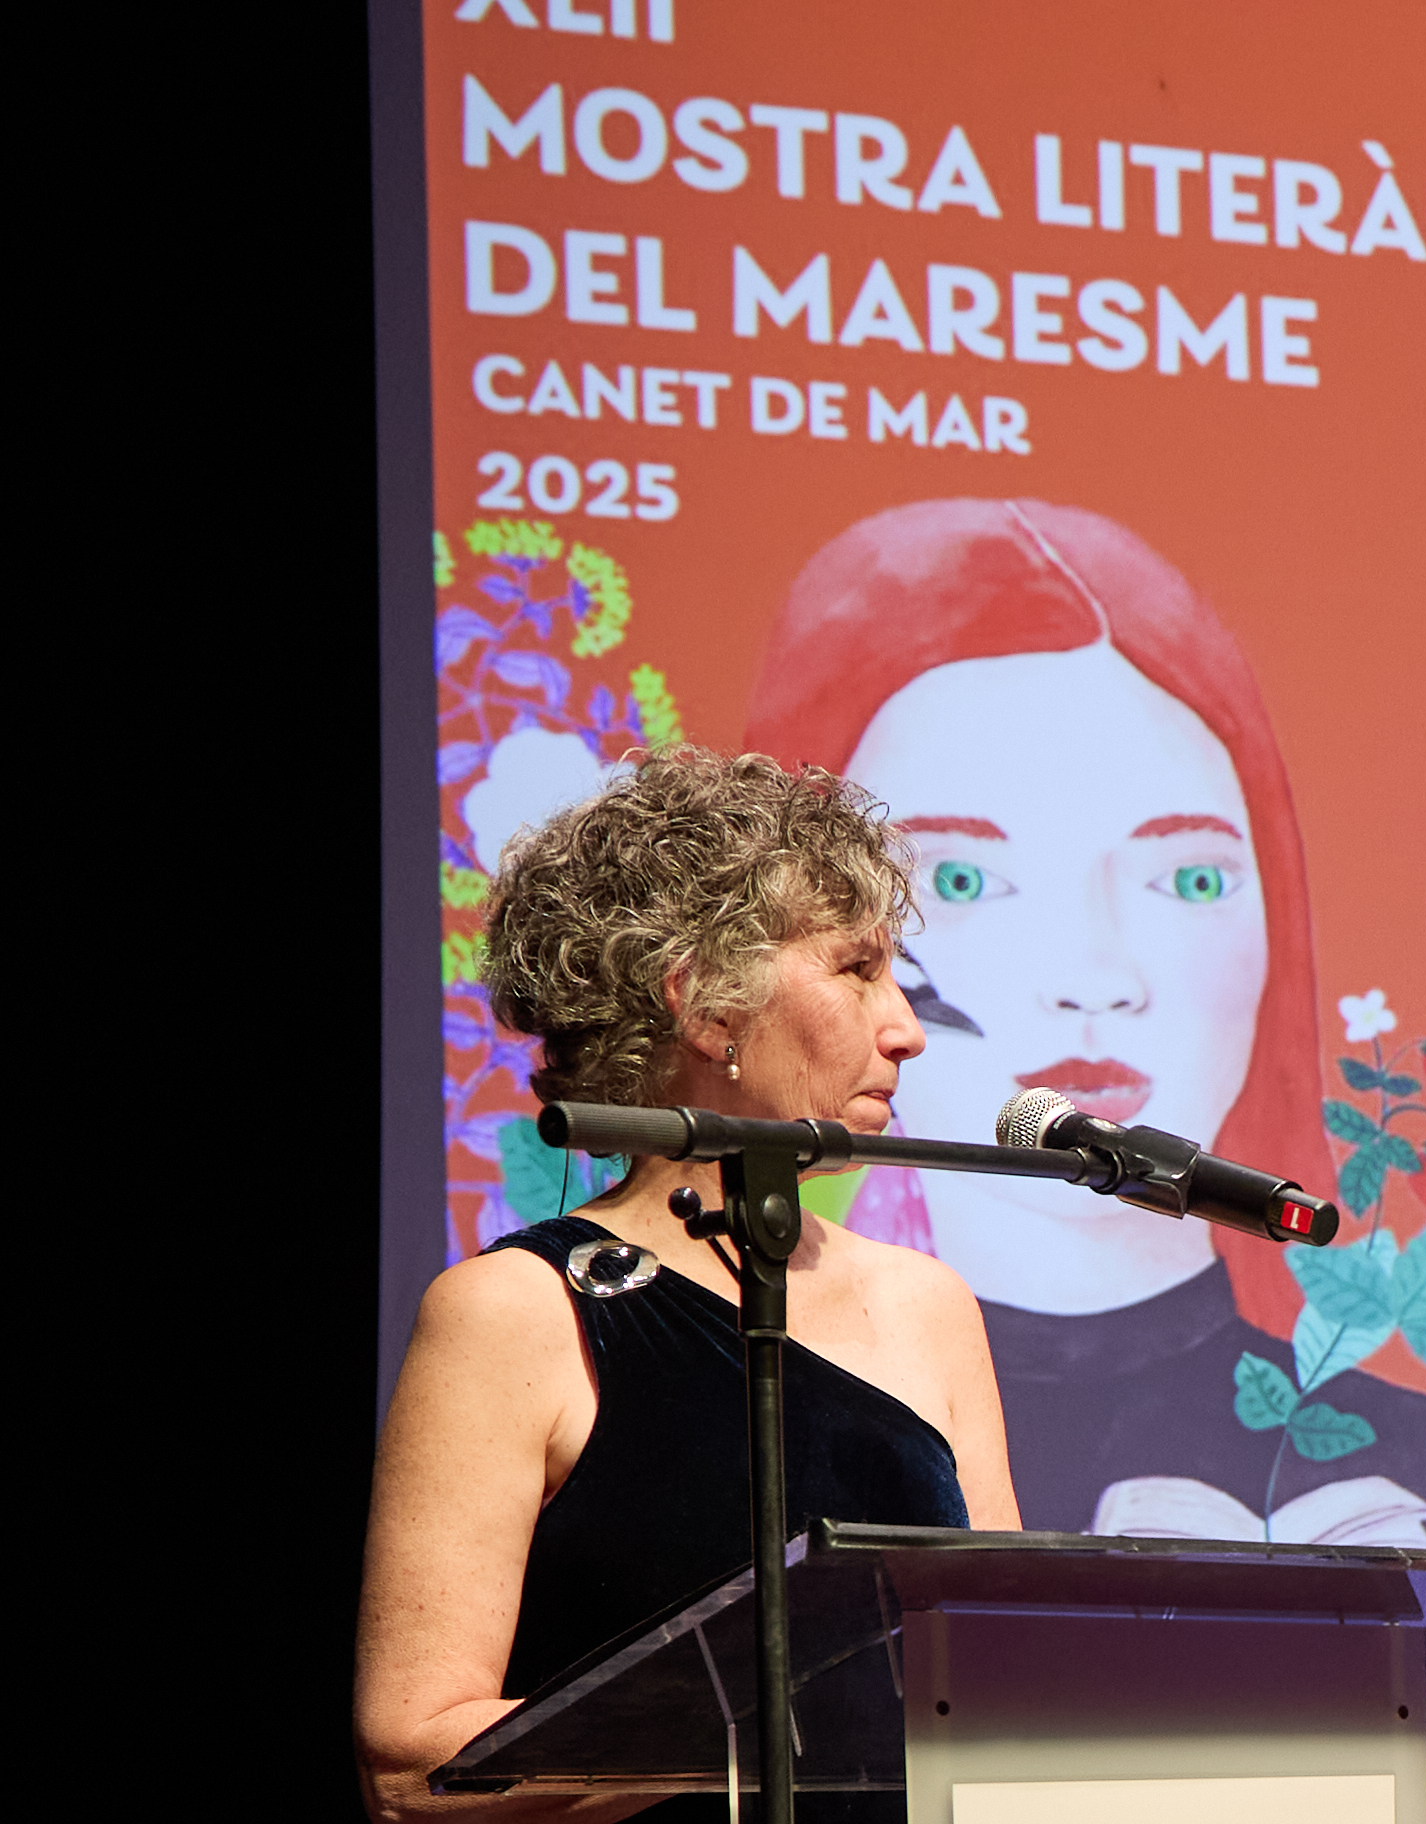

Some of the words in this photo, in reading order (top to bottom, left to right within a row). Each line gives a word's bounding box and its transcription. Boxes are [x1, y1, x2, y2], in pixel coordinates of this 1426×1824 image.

[462, 74, 1001, 219] MOSTRA
[463, 219, 697, 332] DEL
[732, 245, 1320, 388] MARESME
[471, 354, 731, 430] CANET
[749, 376, 848, 440] DE
[867, 387, 1031, 455] MAR
[476, 451, 679, 521] 2025
